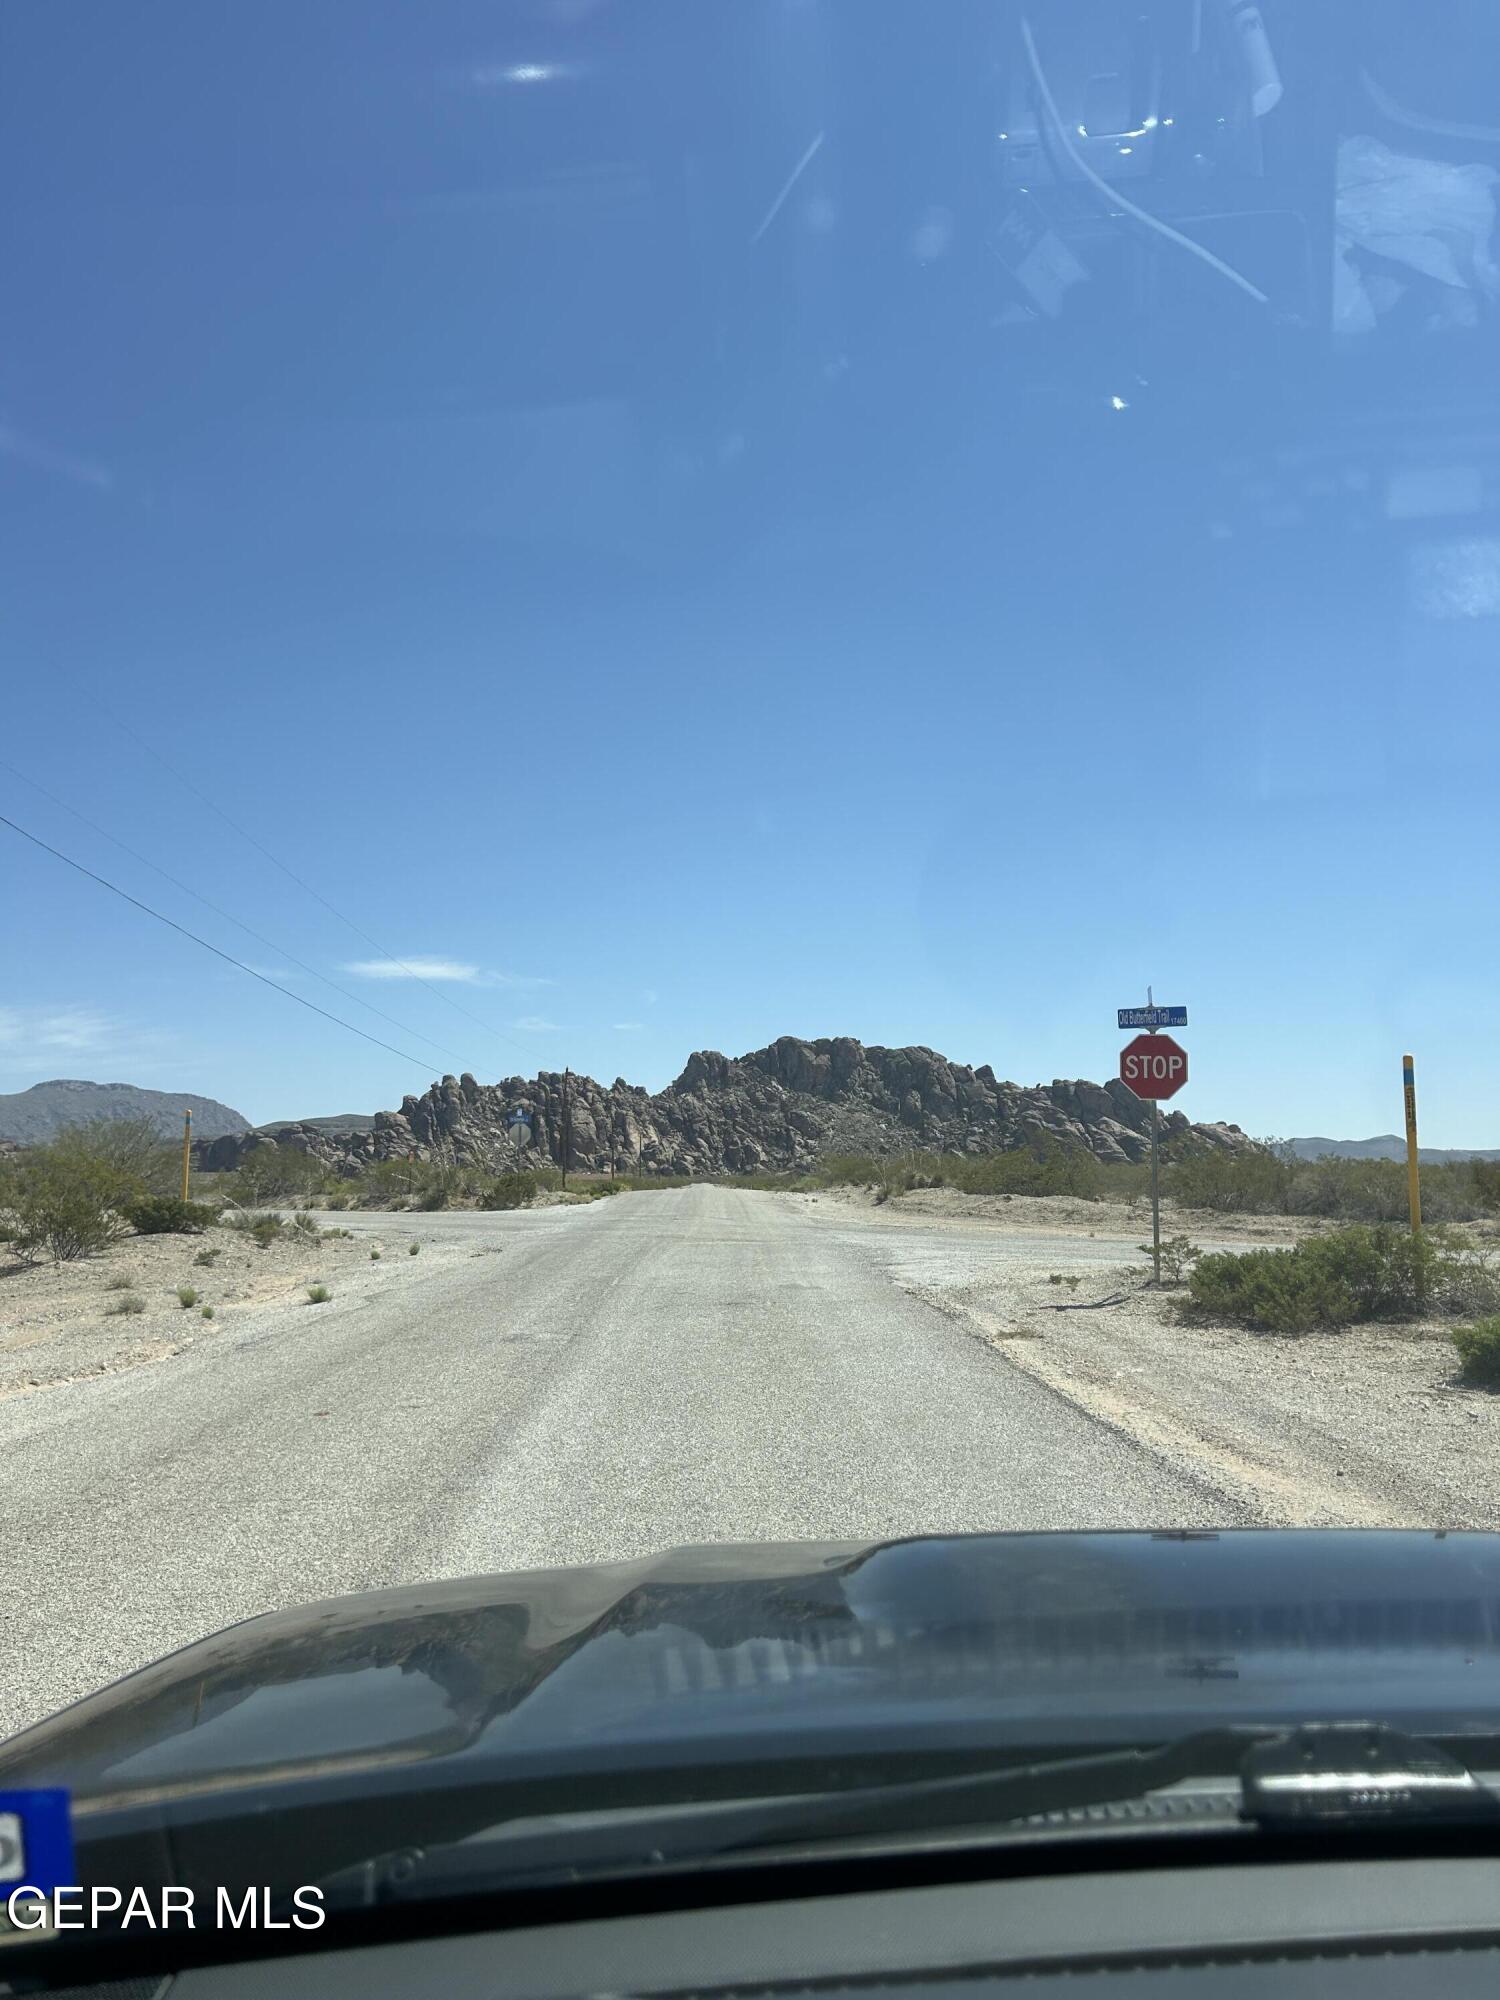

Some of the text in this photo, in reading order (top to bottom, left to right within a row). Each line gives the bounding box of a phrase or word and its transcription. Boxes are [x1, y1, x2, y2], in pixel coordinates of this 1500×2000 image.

[1119, 1010, 1128, 1024] Old
[1157, 1009, 1169, 1024] Trail
[1125, 1055, 1183, 1079] STOP
